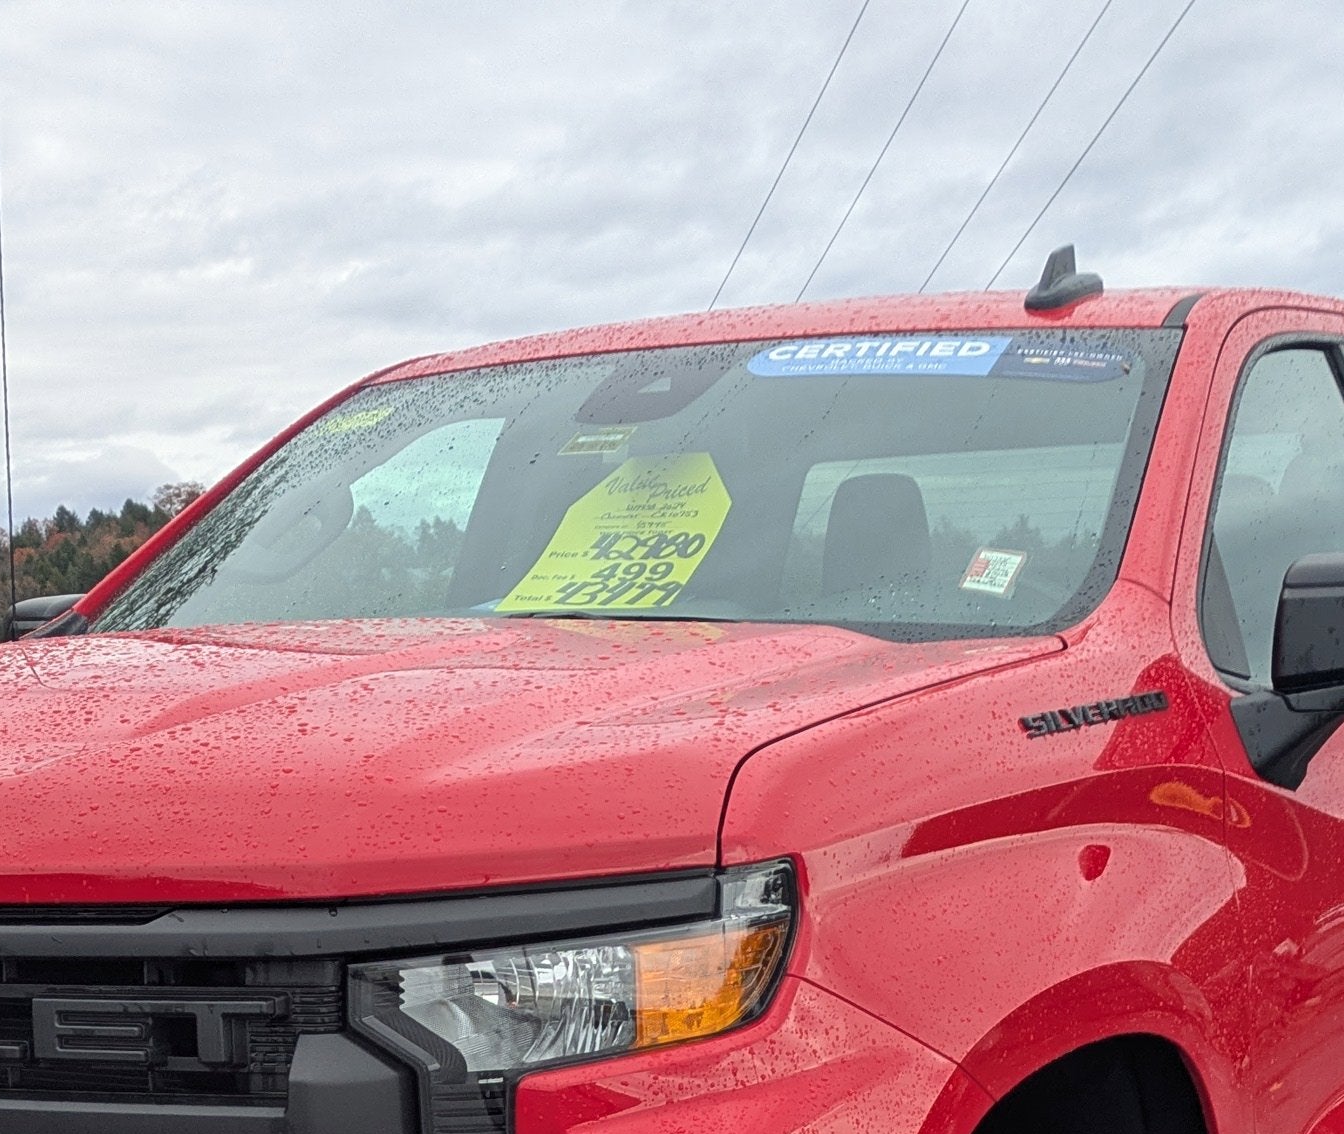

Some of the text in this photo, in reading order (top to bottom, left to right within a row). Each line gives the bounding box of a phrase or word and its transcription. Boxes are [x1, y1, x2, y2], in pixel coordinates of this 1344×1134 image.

[768, 340, 991, 361] CERTIFIED
[606, 474, 712, 503] Value Priced
[548, 550, 579, 559] Price
[590, 561, 674, 582] 499
[1018, 690, 1169, 739] SILVERADO
